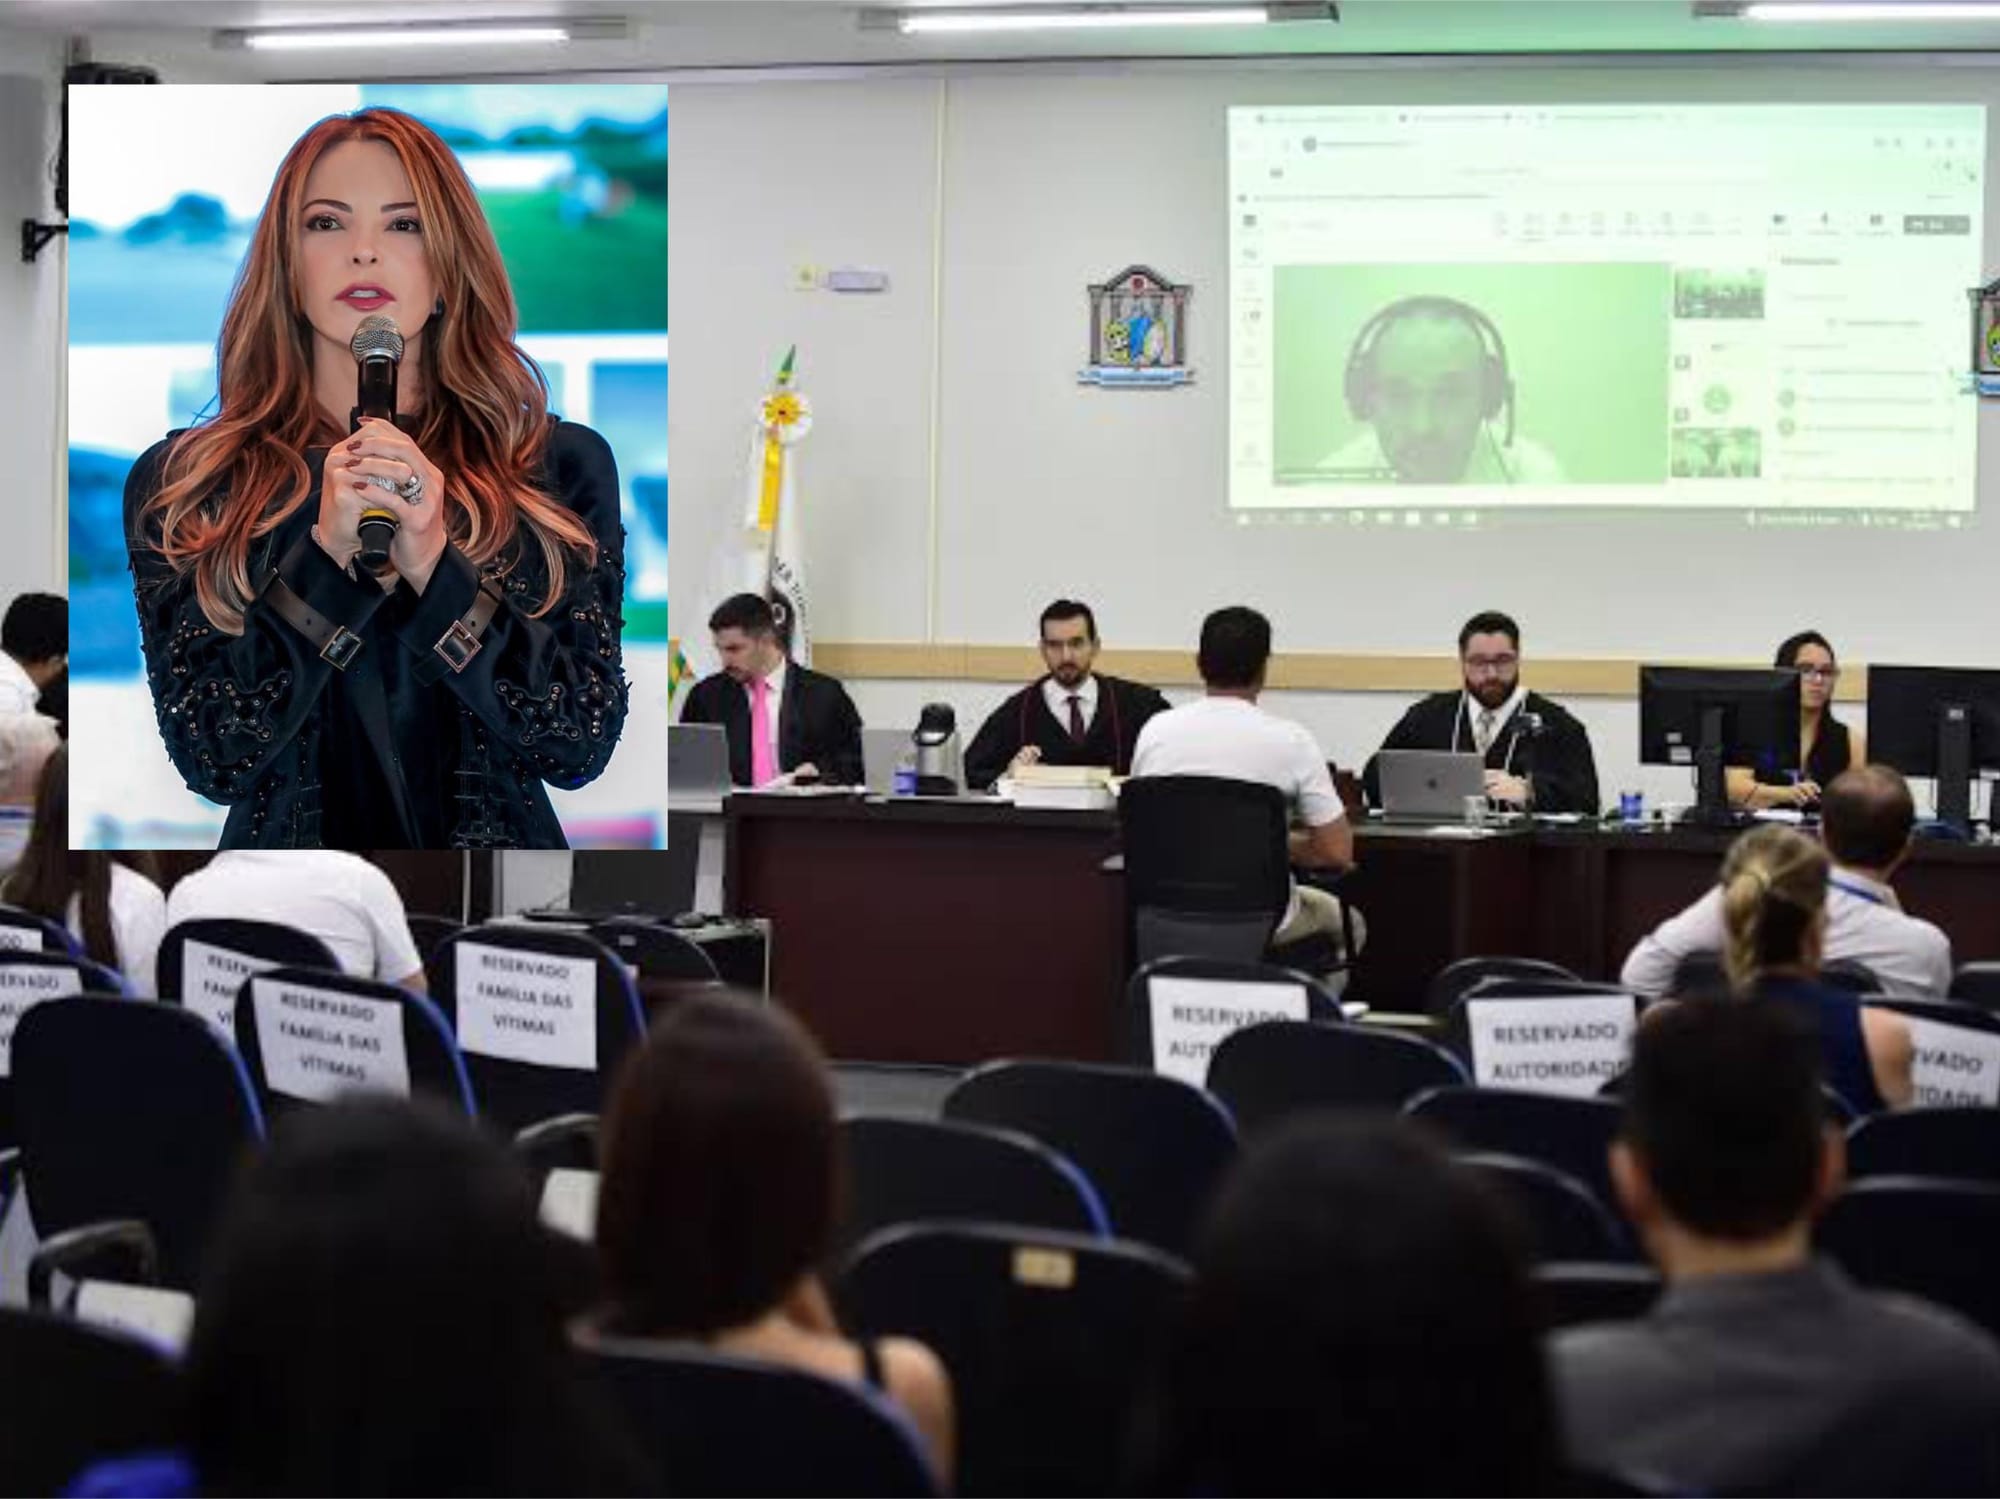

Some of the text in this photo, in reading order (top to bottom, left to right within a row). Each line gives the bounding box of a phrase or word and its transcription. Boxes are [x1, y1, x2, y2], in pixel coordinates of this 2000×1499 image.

[481, 954, 570, 979] RESERVADO
[280, 992, 375, 1022] RESERVADO
[542, 993, 574, 1009] DAS
[347, 1034, 381, 1053] DAS
[1493, 1023, 1619, 1045] RESERVADO
